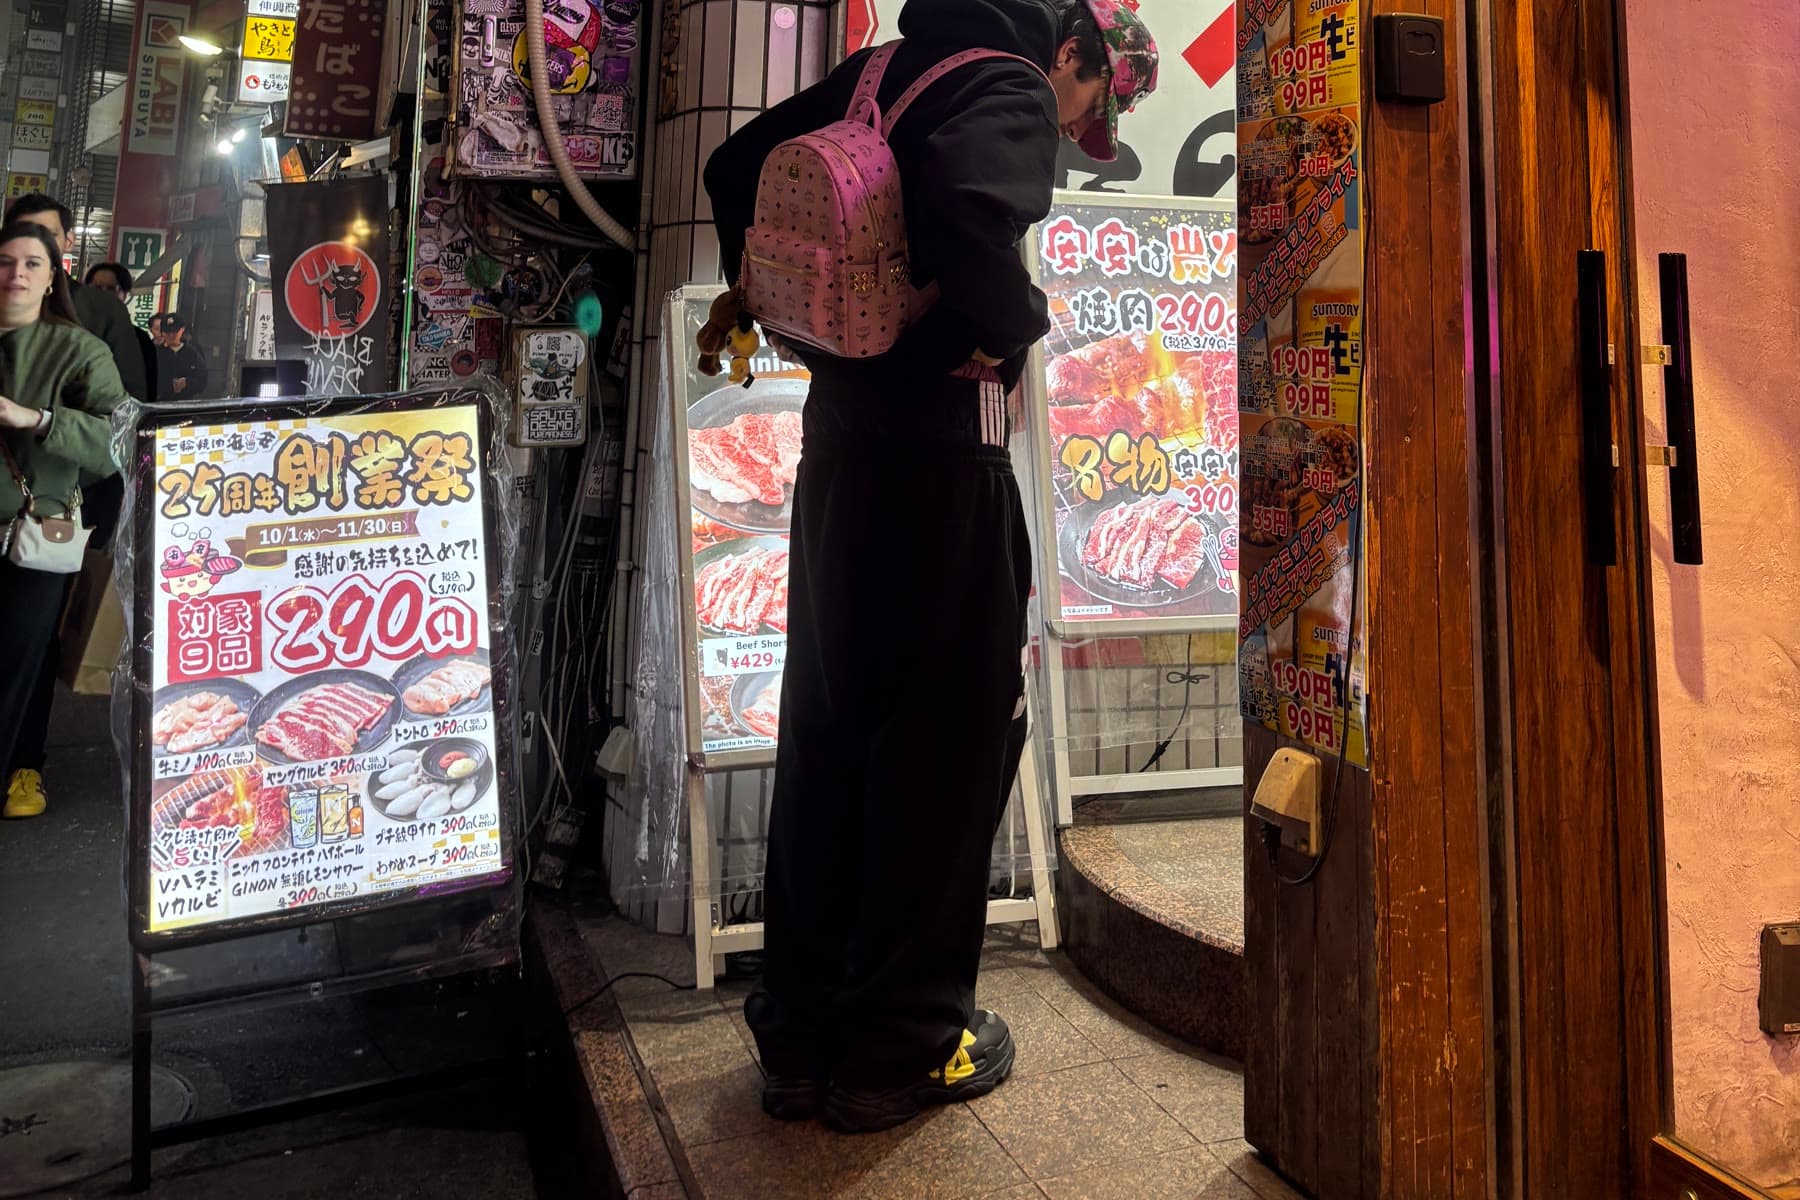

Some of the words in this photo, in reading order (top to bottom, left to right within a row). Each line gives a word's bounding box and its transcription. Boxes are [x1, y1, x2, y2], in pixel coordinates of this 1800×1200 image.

[251, 21, 297, 37] やきと
[303, 0, 371, 117] たばこ
[1270, 38, 1328, 79] 190円
[134, 53, 155, 138] SHIBUYA
[149, 56, 183, 136] LABI
[1282, 73, 1328, 109] 99円
[1312, 303, 1359, 317] SUNTORY
[1271, 346, 1331, 379] 190円
[1284, 383, 1331, 417] 99円
[731, 652, 774, 669] ¥429
[736, 641, 757, 650] Beef
[1272, 661, 1333, 710] 190円
[395, 725, 429, 742] トントロ
[1287, 702, 1334, 749] 99円
[266, 763, 328, 785] ヤングカルビ
[376, 850, 439, 875] わかめスープ
[232, 877, 278, 897] GINON
